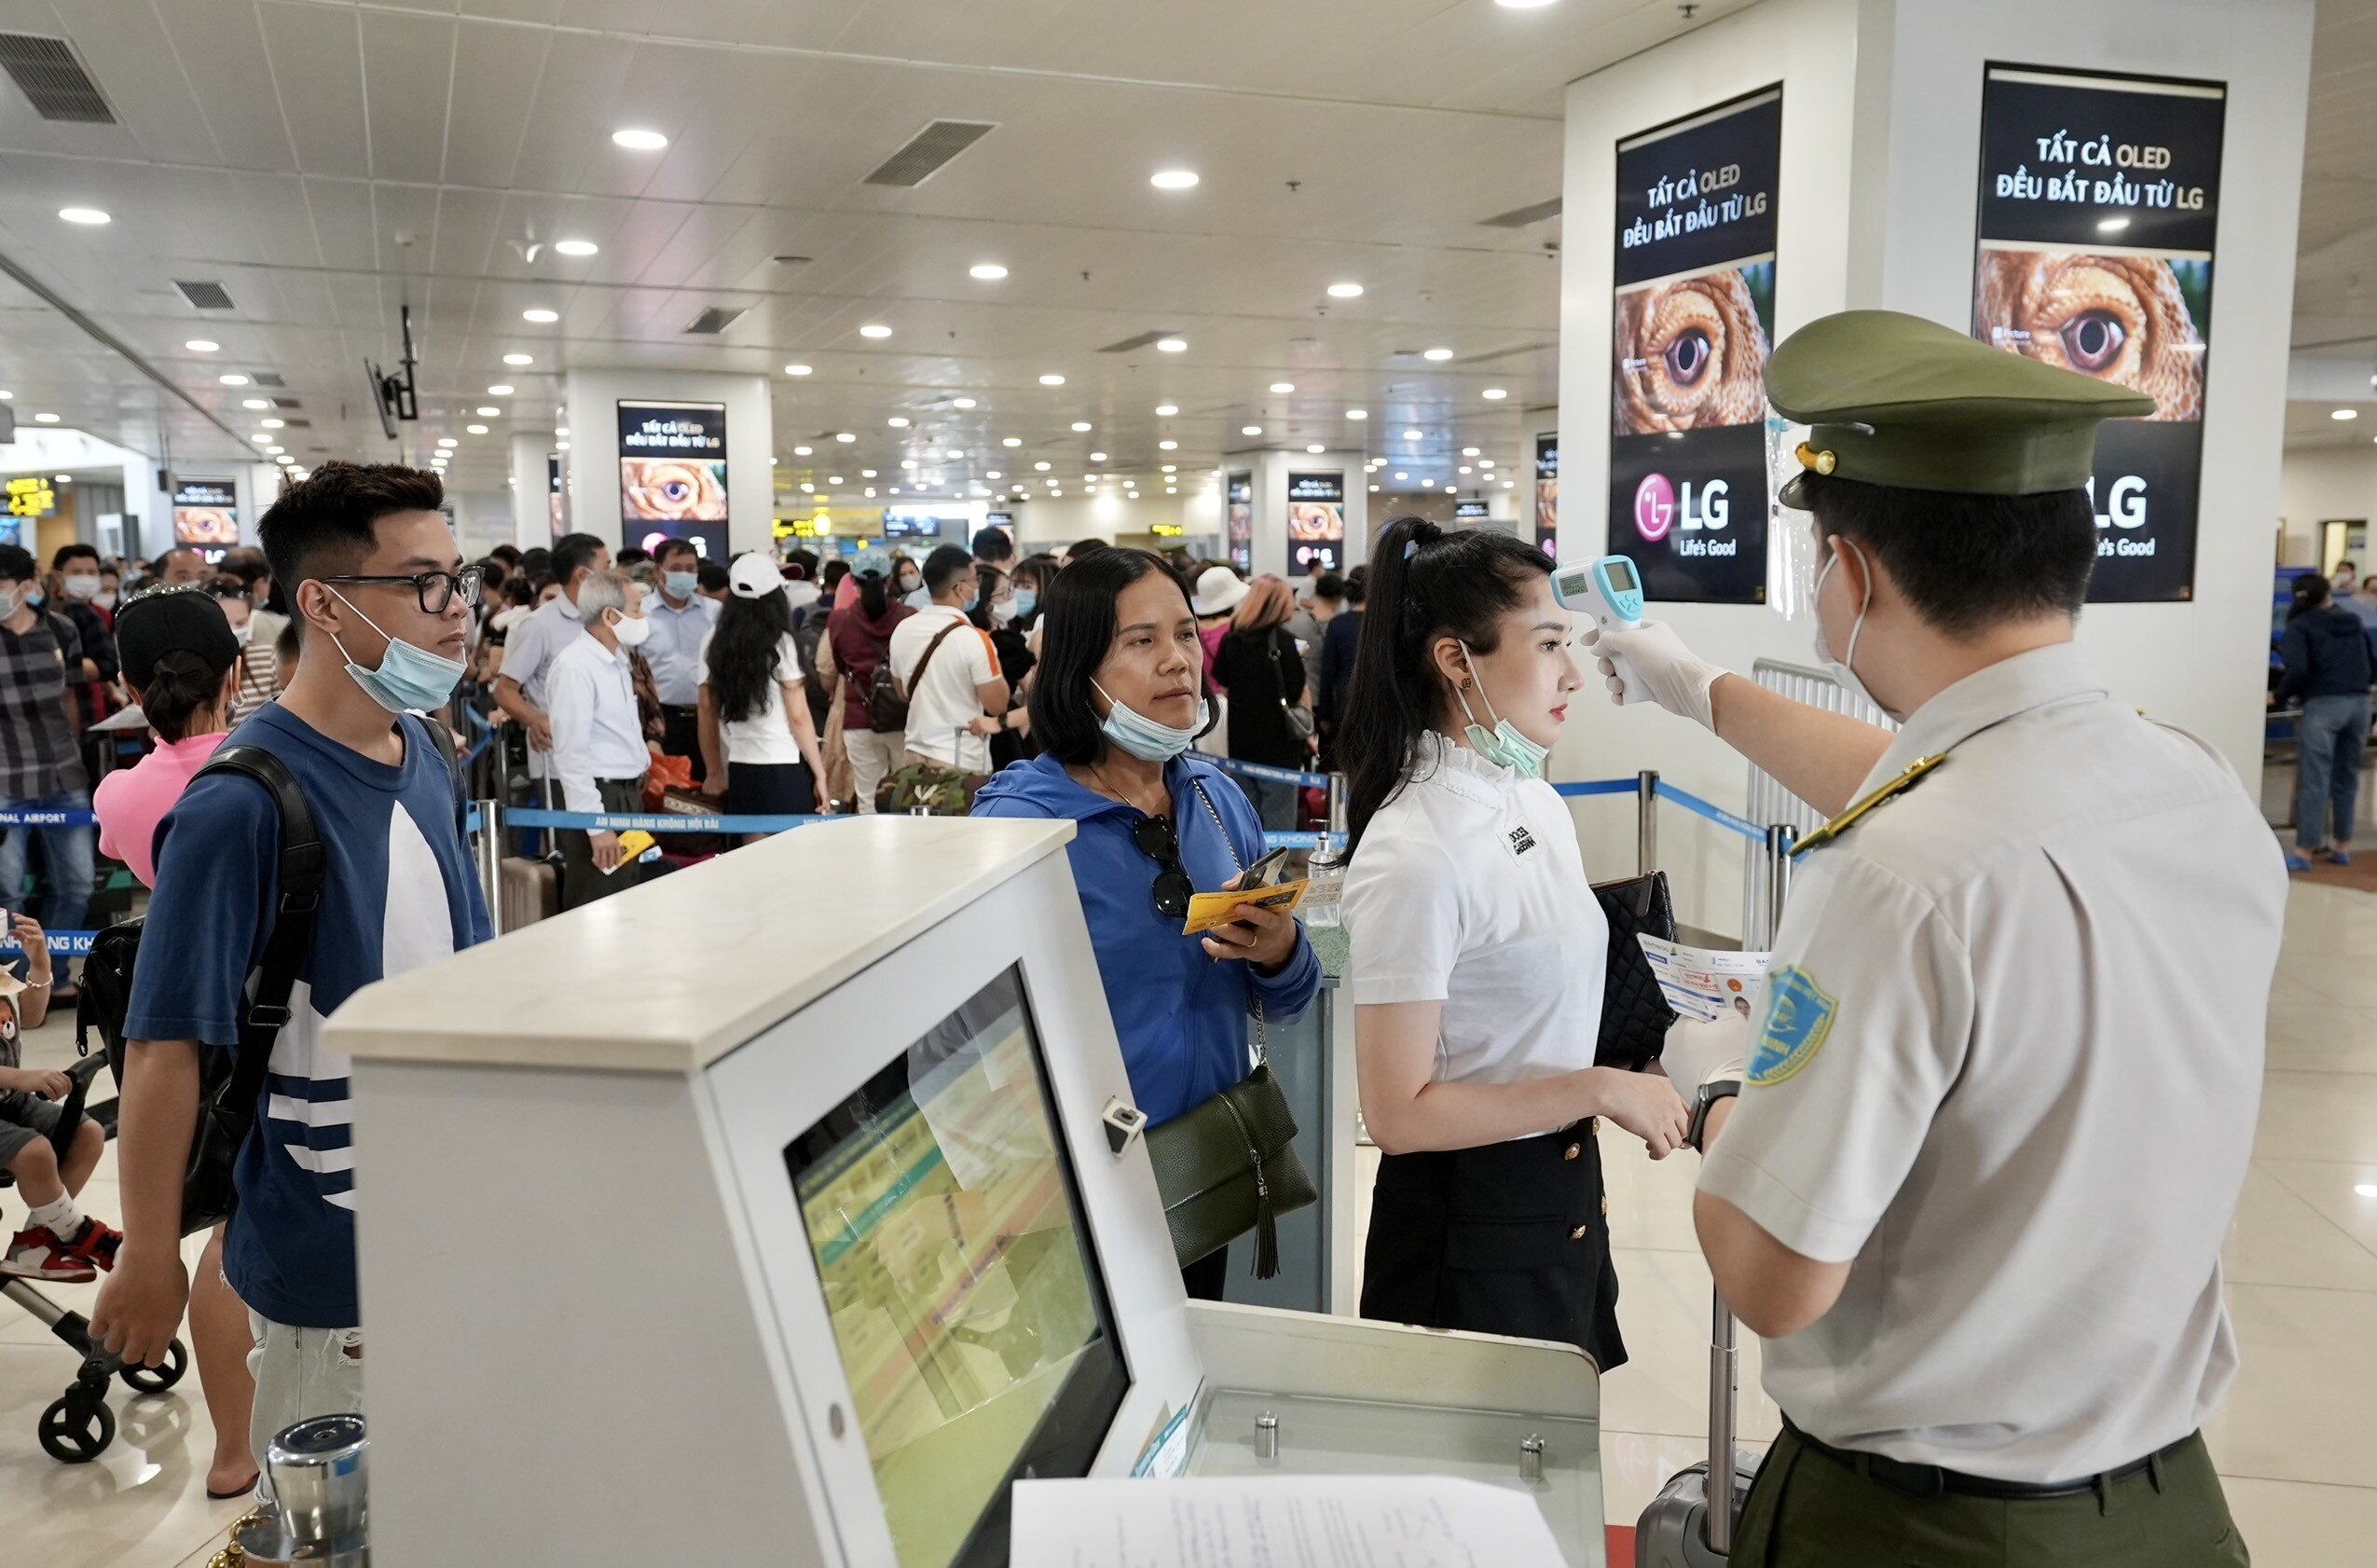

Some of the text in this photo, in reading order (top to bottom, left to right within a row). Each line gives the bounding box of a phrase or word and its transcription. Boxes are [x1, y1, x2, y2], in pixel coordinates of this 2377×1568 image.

[2037, 129, 2171, 170] TẤT CẢ OLED
[1648, 164, 1740, 209] TẤT CẢ OLED
[1996, 164, 2042, 199] ĐỀU
[2094, 171, 2140, 206] ĐẦU
[2144, 178, 2175, 208] TỪ
[2177, 186, 2204, 210] LG
[1745, 191, 1766, 217] LG
[1681, 478, 1728, 530] LG
[1680, 539, 1736, 557] Life's Good
[2117, 538, 2155, 557] Good
[23, 813, 66, 823] AIRPORT
